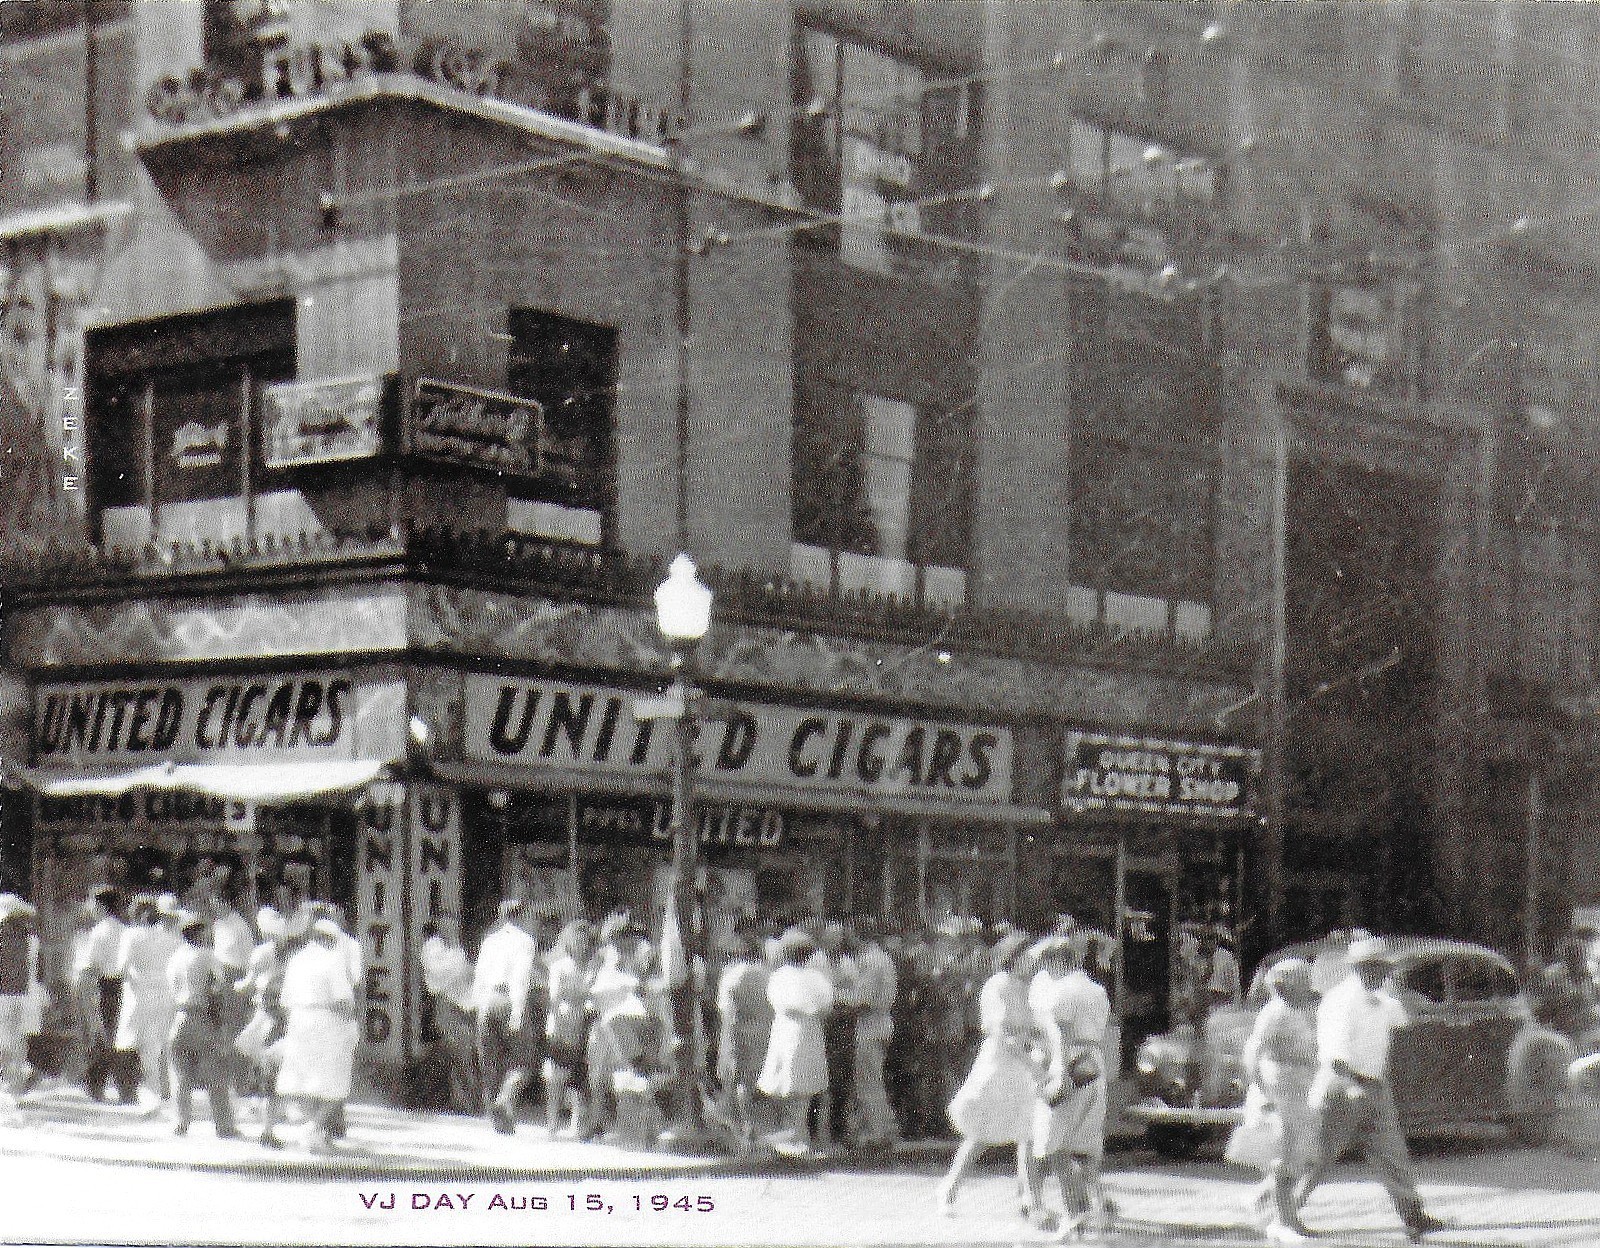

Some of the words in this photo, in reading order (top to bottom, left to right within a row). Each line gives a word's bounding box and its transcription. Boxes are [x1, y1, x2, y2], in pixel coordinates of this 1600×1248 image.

[40, 686, 185, 754] UNITED
[195, 679, 351, 749] CIGARS
[489, 685, 758, 771] UNITD
[787, 715, 999, 791] CIGARS
[1074, 769, 1171, 799] FLOWER
[1179, 776, 1241, 803] SHOP
[1099, 750, 1170, 774] QUEEN
[1176, 756, 1222, 777] CITY
[651, 800, 784, 846] UITED
[365, 803, 392, 1045] UNITED
